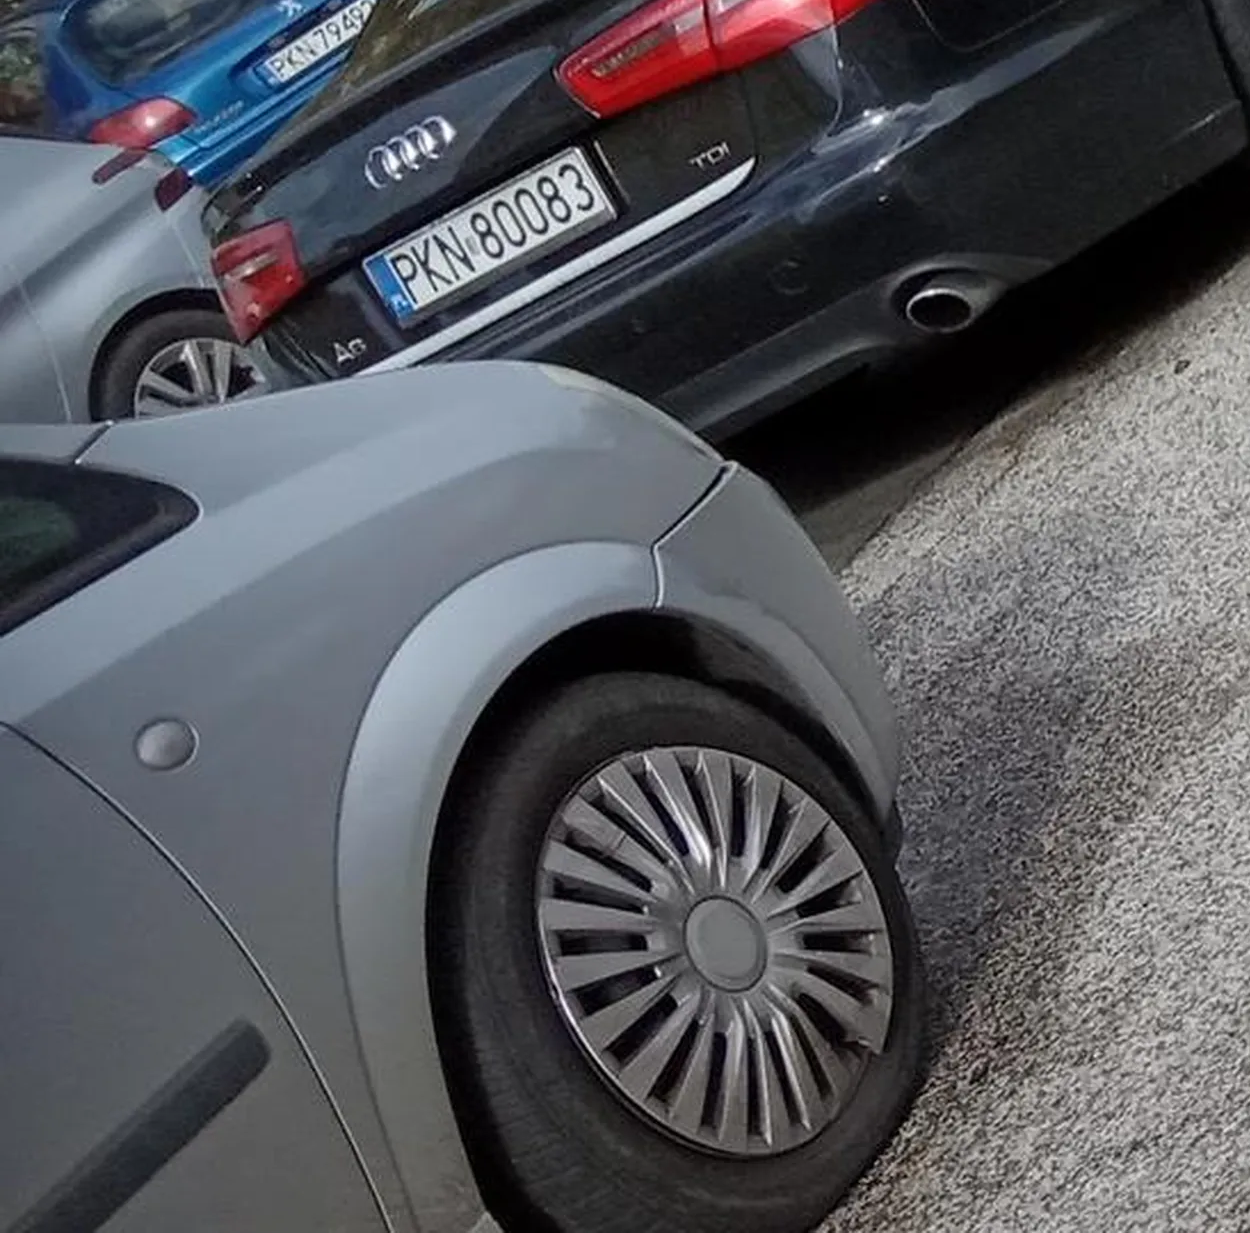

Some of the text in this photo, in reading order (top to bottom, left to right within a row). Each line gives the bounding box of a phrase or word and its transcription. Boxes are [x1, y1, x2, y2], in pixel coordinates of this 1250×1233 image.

[270, 39, 317, 78] PKN
[689, 142, 731, 170] TDI
[392, 165, 594, 304] PKN 80083
[333, 338, 367, 362] A6
